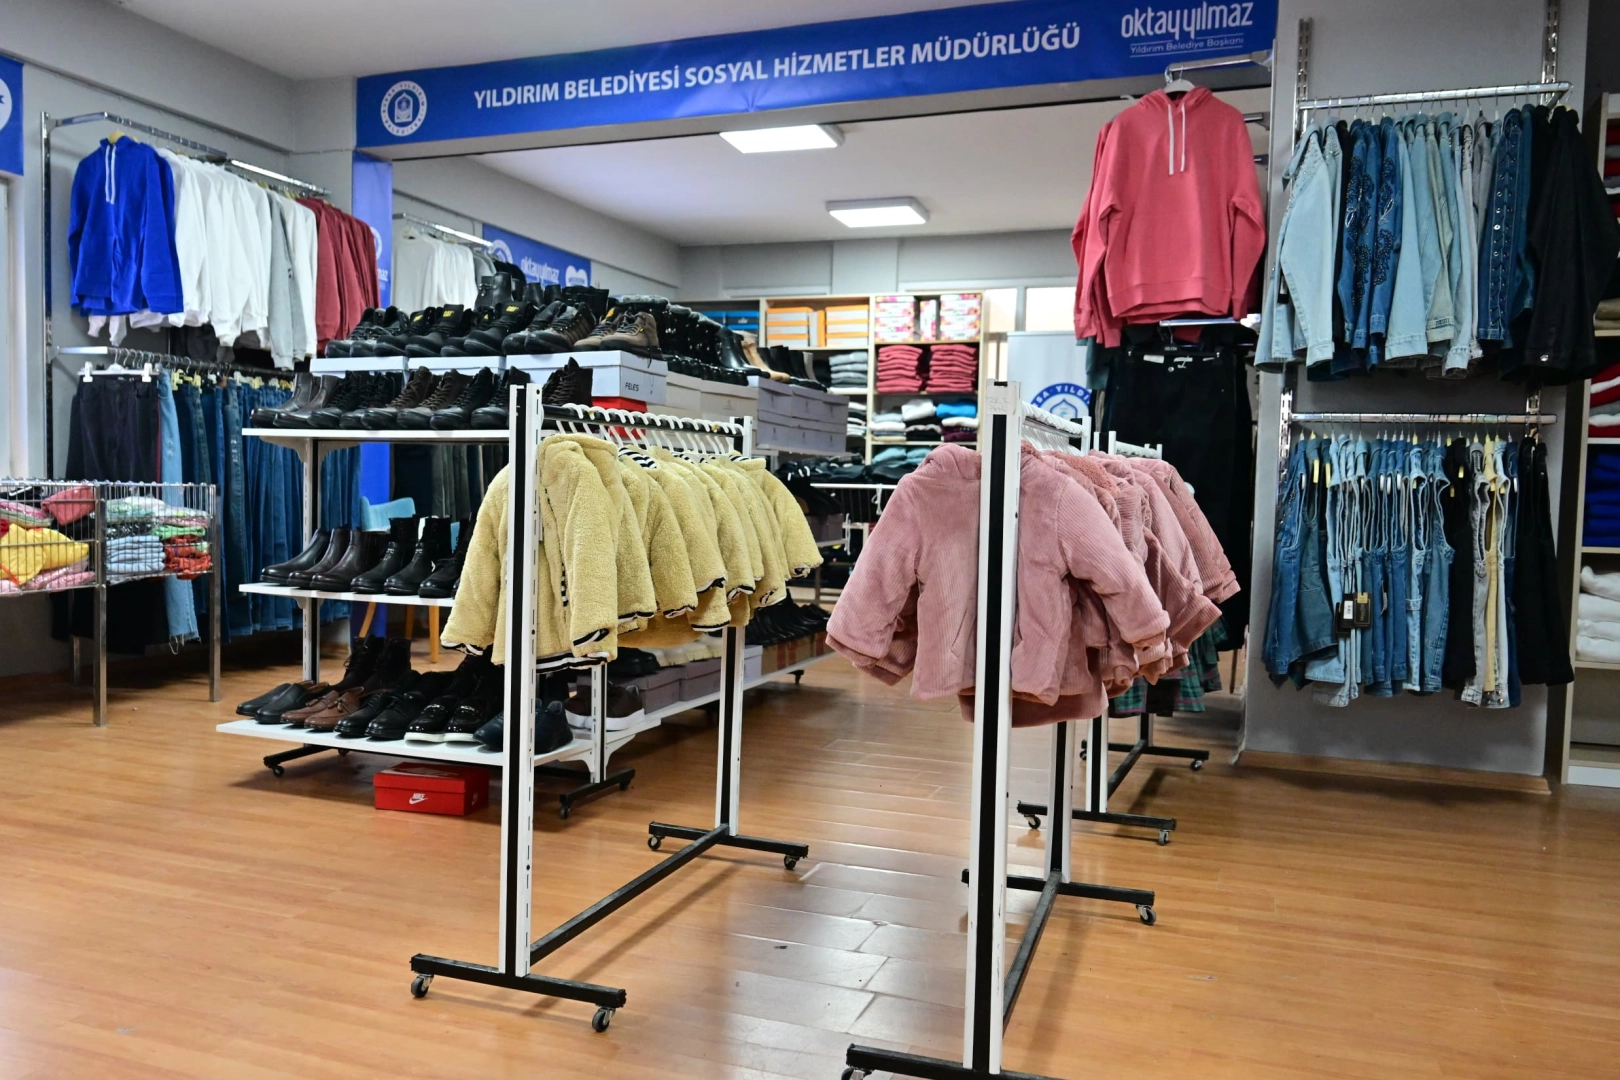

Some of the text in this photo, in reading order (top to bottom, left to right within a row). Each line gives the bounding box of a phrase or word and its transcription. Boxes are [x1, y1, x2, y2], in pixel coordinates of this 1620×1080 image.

[1166, 40, 1205, 52] Belediye
[474, 21, 1081, 109] YILDIRIM BELEDİYESİ SOSYAL HİZMETLER MÜDÜRLÜĞÜ
[625, 382, 640, 392] FELES
